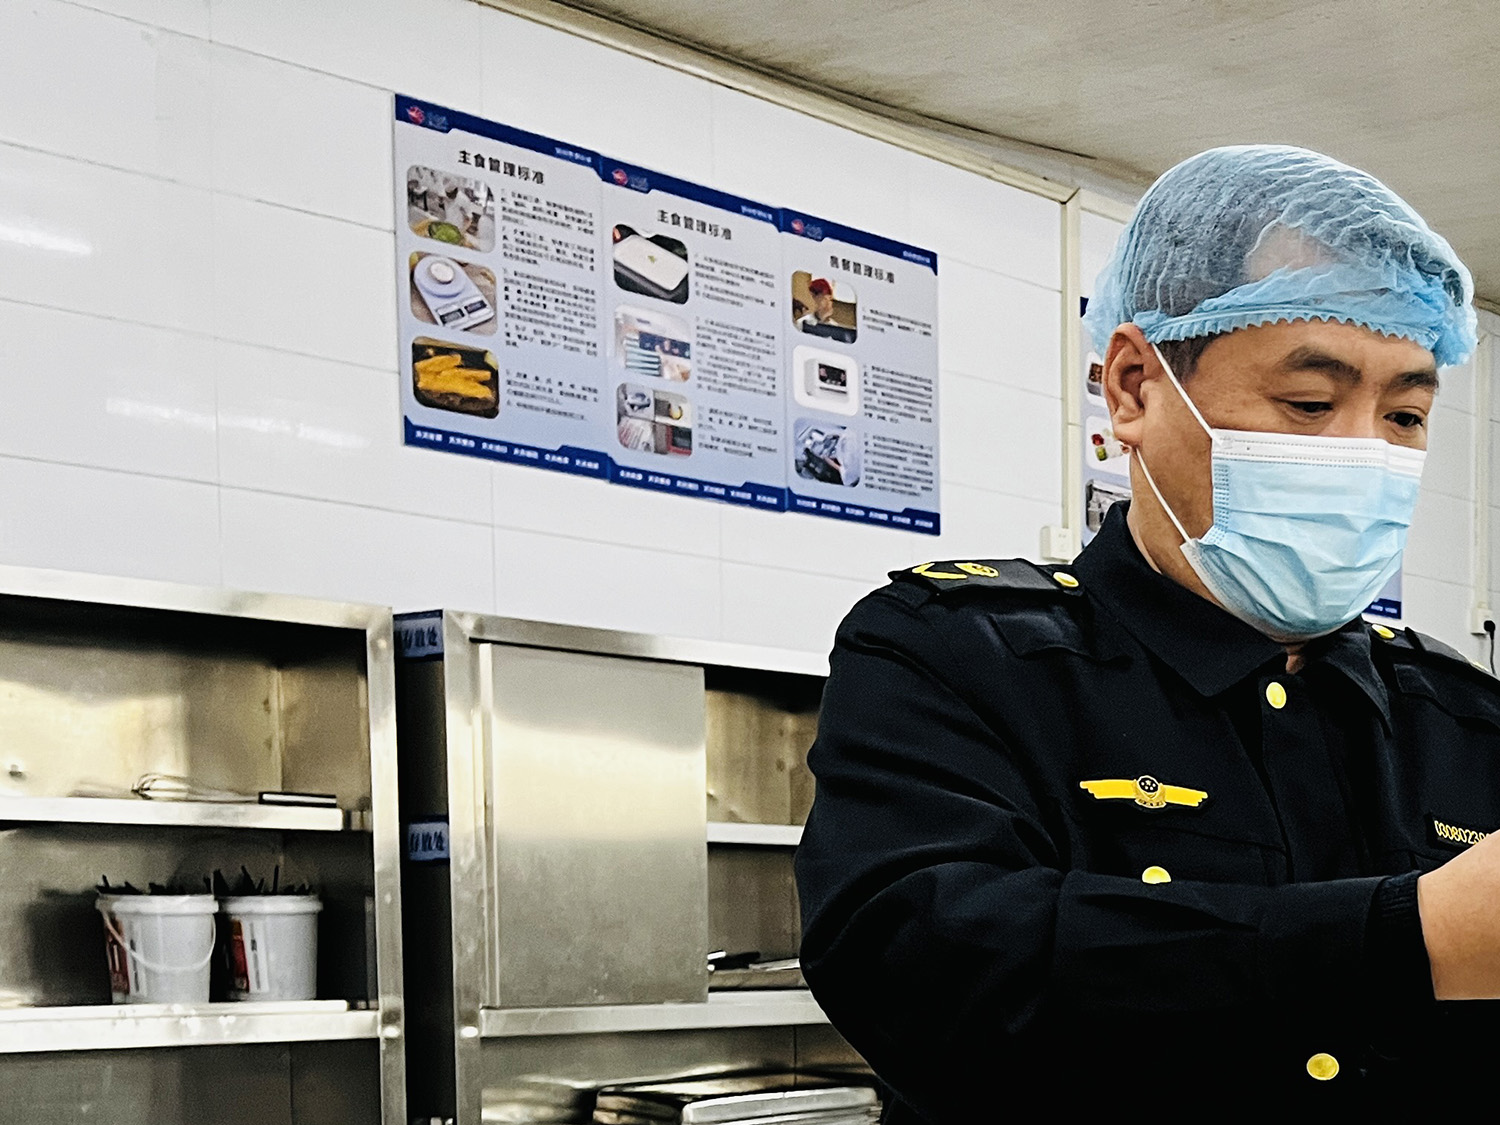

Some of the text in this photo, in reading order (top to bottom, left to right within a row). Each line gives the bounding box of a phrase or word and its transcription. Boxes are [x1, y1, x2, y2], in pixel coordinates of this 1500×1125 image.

[458, 150, 545, 185] 主食管理标准
[657, 209, 732, 240] 主食管理标准
